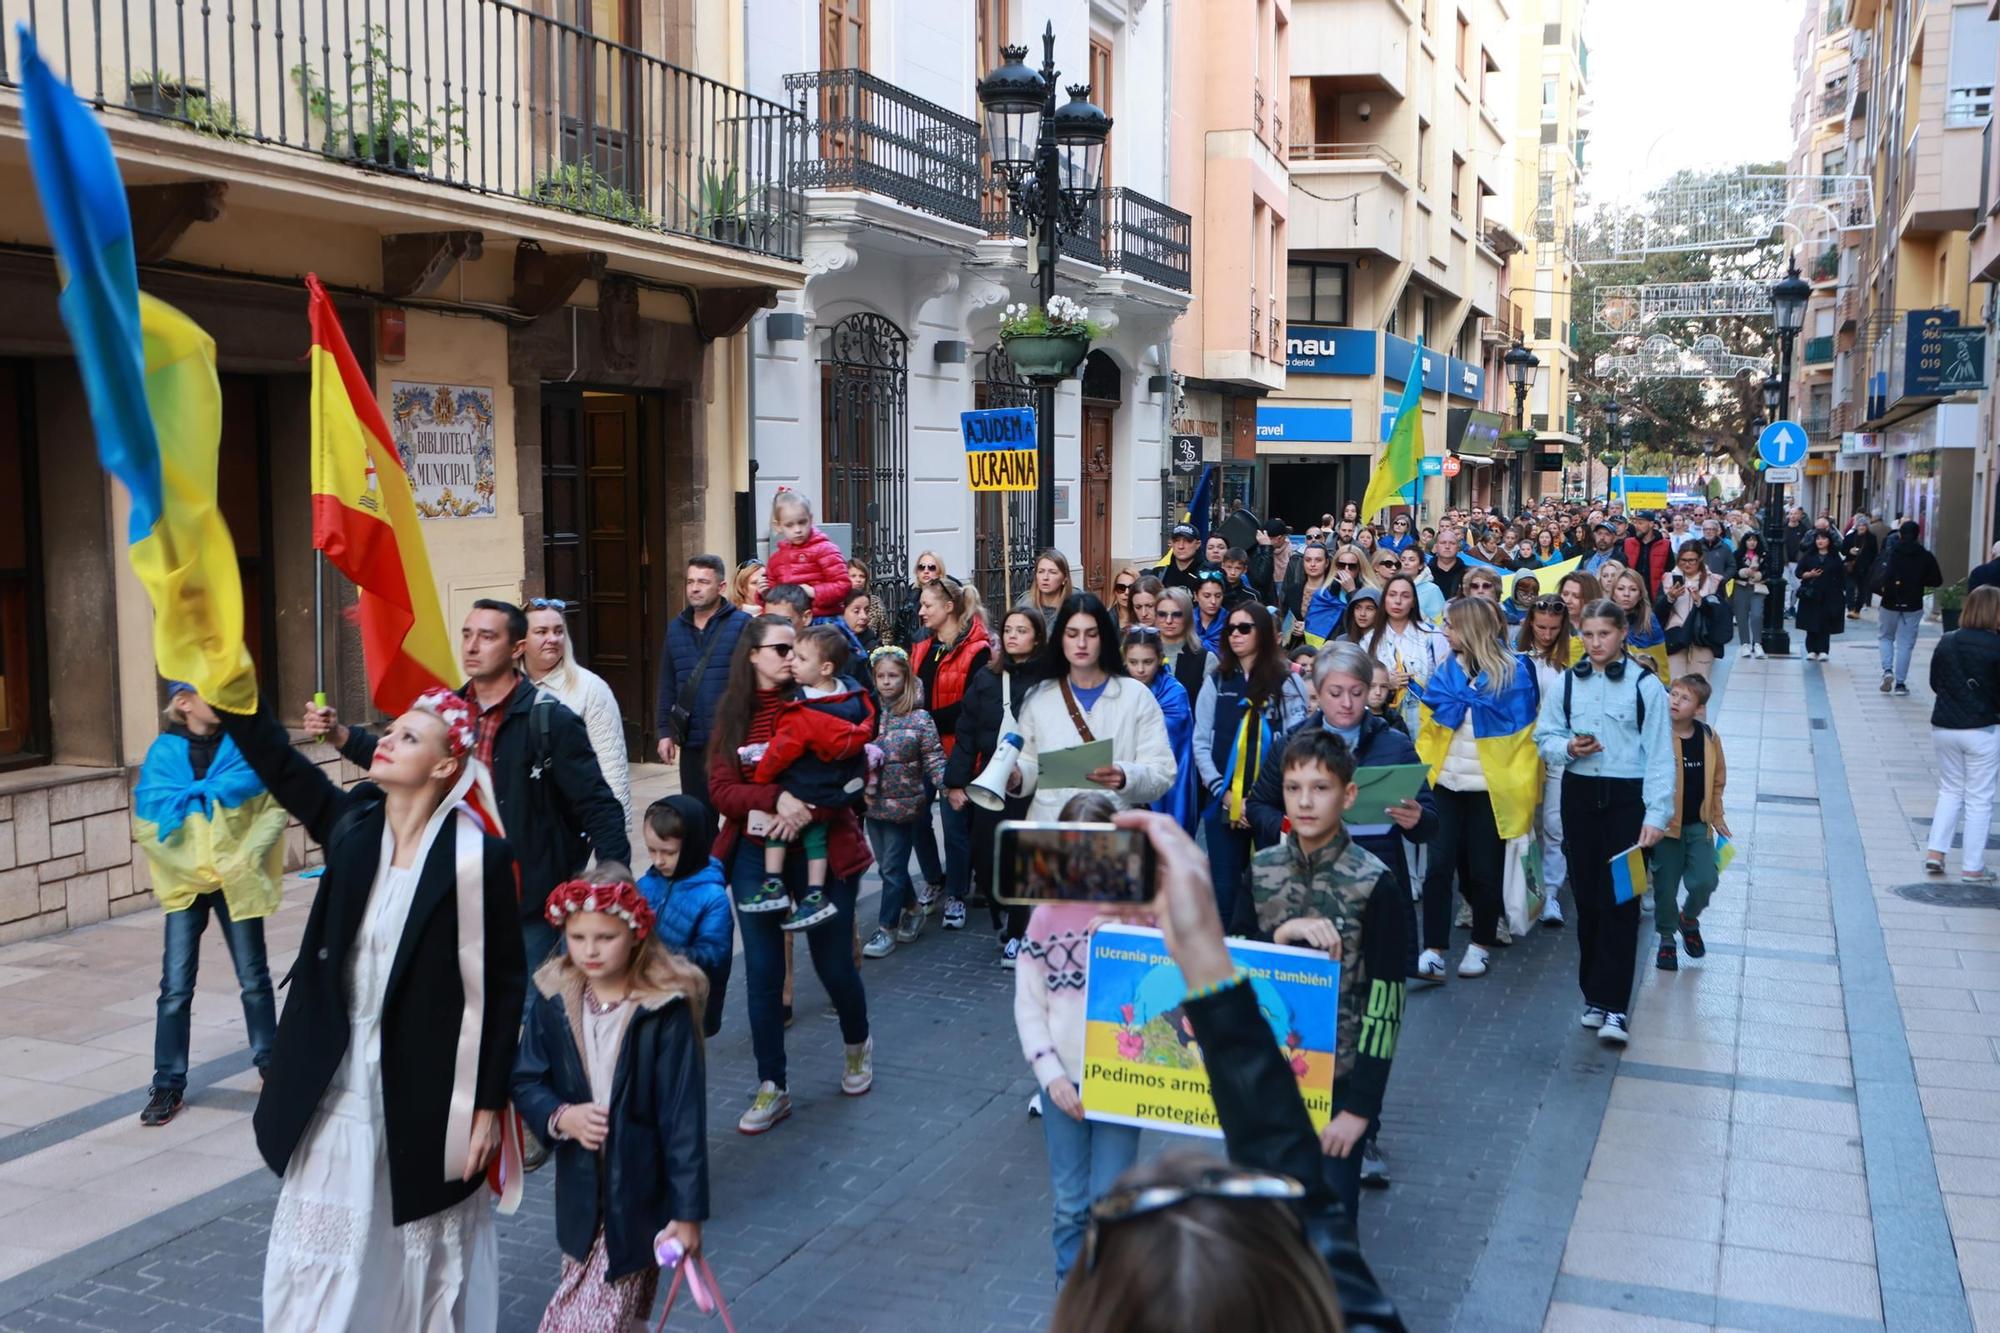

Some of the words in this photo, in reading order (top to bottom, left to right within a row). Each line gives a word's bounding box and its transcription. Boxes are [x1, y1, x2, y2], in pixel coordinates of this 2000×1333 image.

[1287, 339, 1335, 356] nau
[1291, 358, 1316, 367] dental
[966, 415, 1023, 446] AJUDEM
[1256, 423, 1284, 436] ravel
[416, 431, 474, 455] BIBLIOTECA
[416, 463, 474, 486] MUNICIPAL
[1084, 1063, 1166, 1089] ¡Pedimos
[1305, 1095, 1331, 1113] uir
